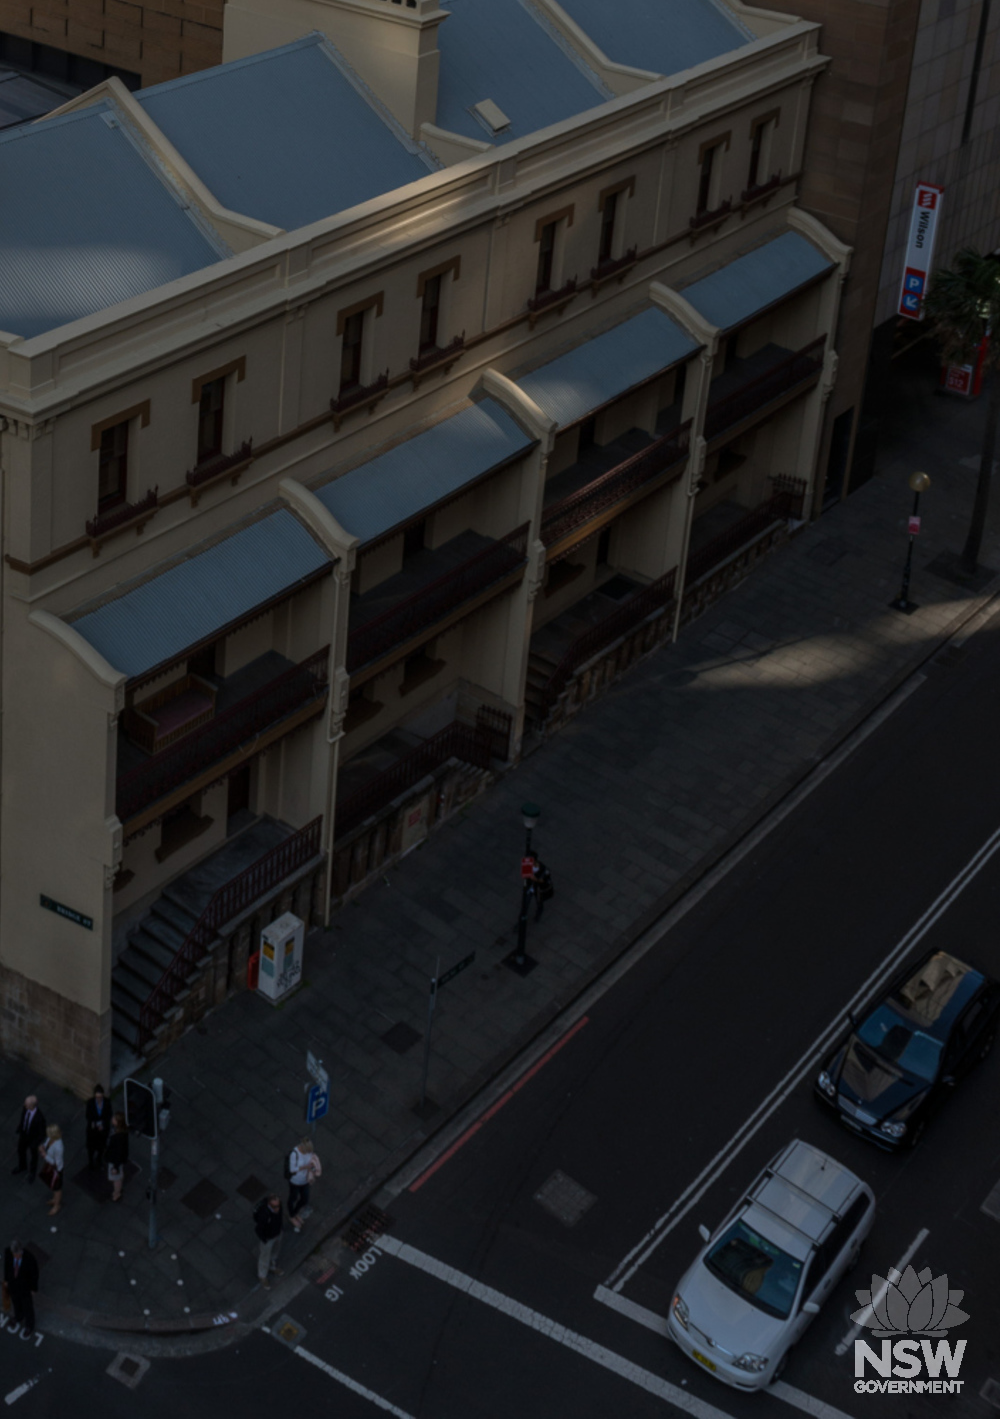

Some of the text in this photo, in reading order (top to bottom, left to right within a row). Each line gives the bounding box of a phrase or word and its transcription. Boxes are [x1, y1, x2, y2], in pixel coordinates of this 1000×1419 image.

[915, 210, 931, 249] Wilson
[909, 277, 919, 289] P
[349, 1246, 383, 1280] LOOK
